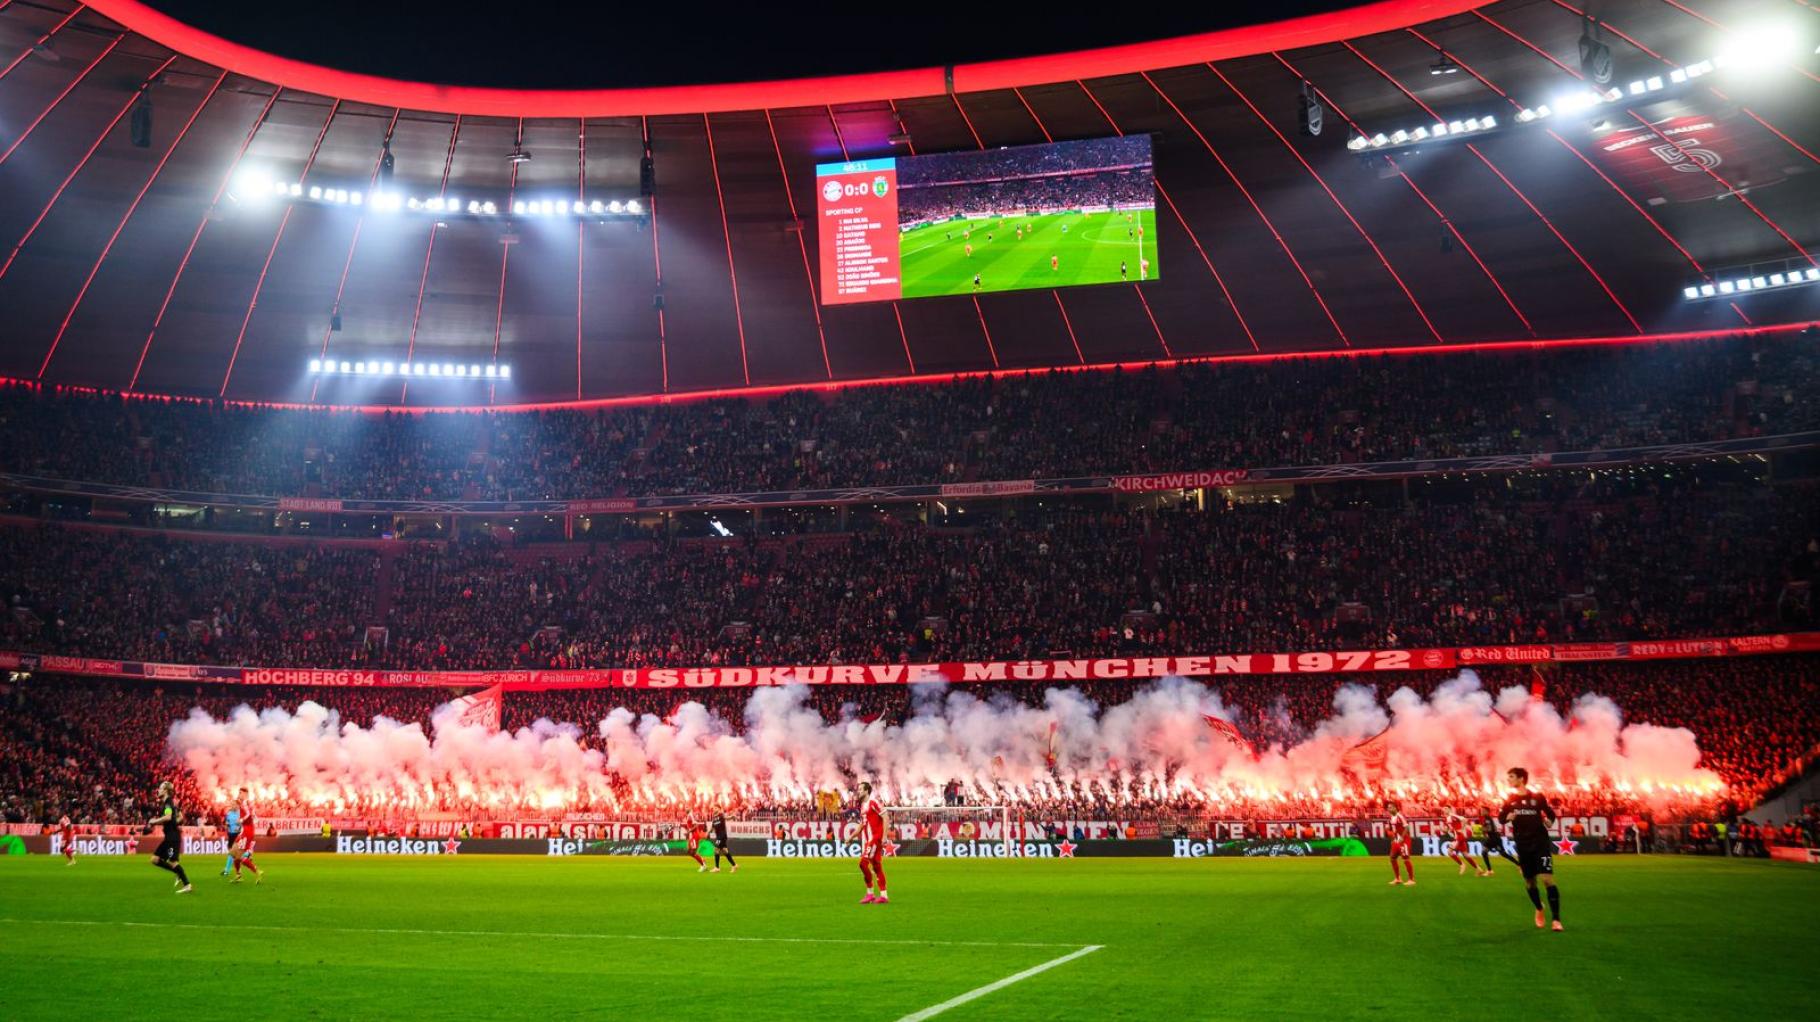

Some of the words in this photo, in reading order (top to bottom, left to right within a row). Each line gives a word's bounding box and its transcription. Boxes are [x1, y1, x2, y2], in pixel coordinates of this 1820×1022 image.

[844, 182, 868, 196] 0:0
[1505, 646, 1550, 660] United
[647, 664, 941, 687] SÜDKURVE
[963, 655, 1251, 681] MÜNCHEN
[1272, 650, 1411, 672] 1972
[245, 668, 348, 686] HÖCHBERG
[276, 820, 322, 830] BRETTEN
[336, 836, 440, 854] Heineken
